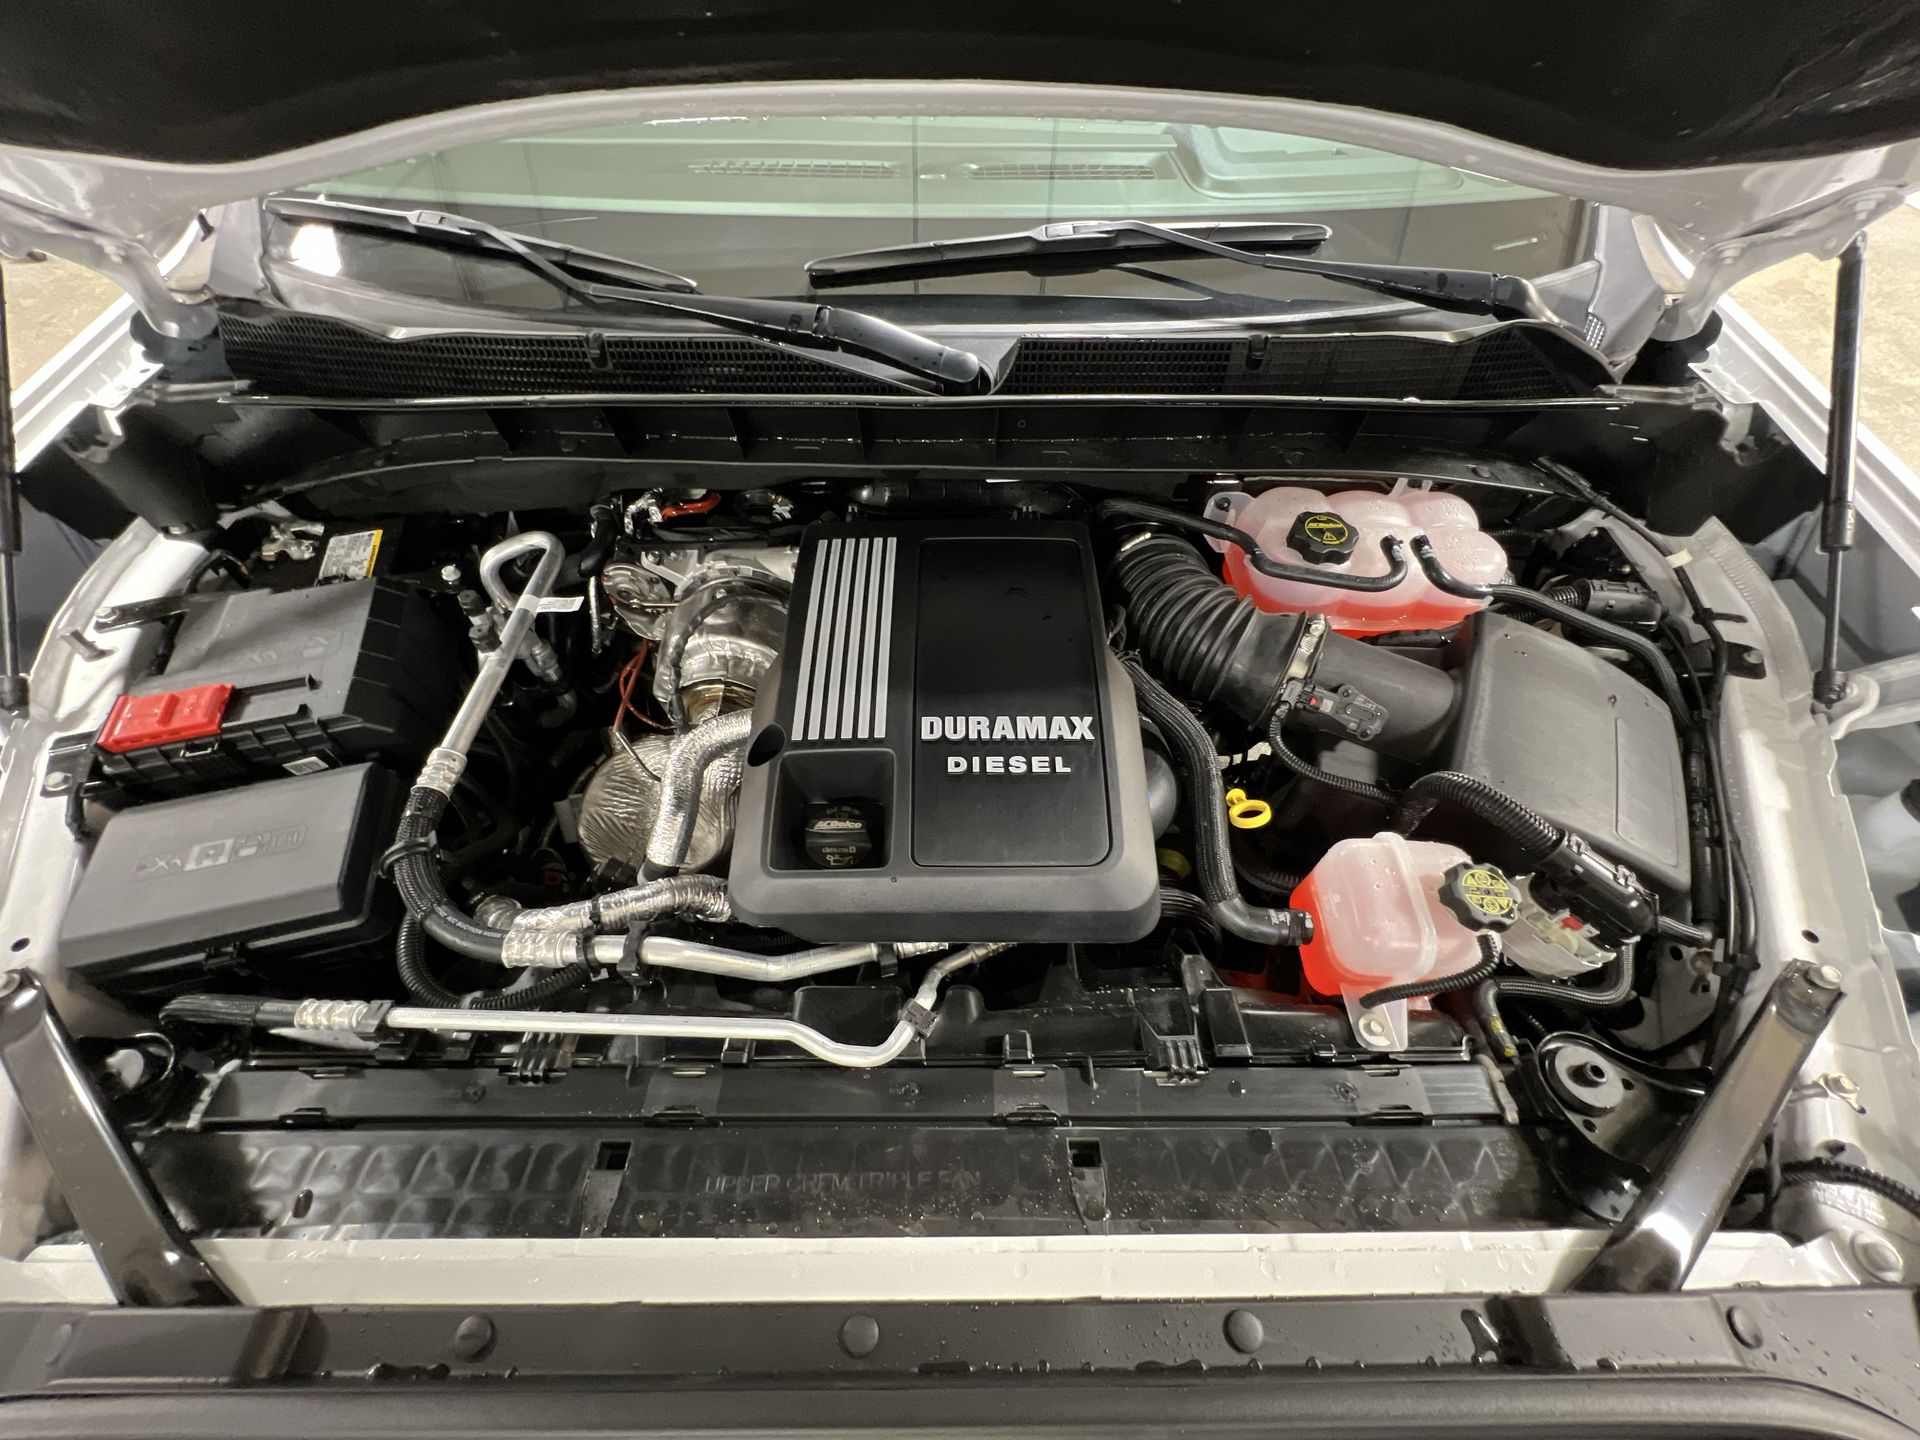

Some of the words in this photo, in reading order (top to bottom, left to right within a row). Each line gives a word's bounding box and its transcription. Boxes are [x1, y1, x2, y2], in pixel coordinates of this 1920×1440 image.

[920, 715, 1096, 742] DURAMAX
[947, 755, 1072, 775] DIESEL
[814, 820, 863, 830] ACDelco
